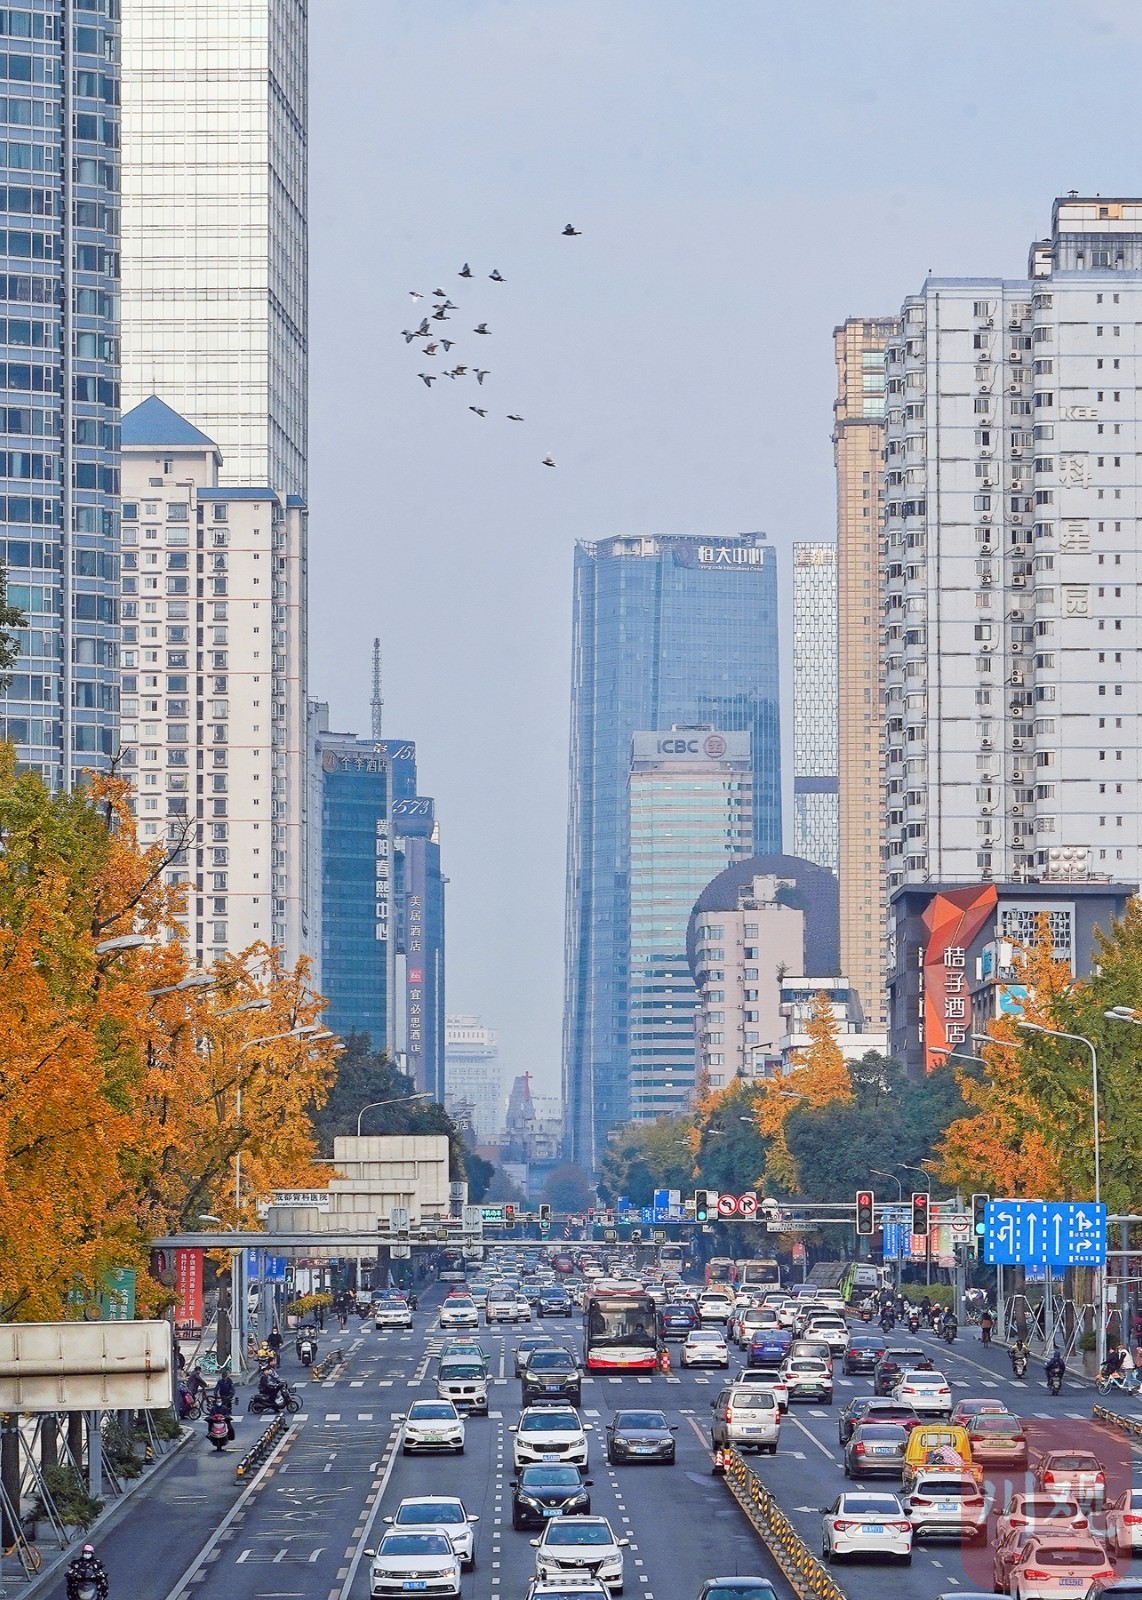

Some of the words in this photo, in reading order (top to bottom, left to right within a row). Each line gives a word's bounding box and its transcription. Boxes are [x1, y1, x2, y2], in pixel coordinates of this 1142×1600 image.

[697, 545, 764, 566] 恒大中心
[656, 738, 699, 754] ICBC
[341, 756, 388, 773] 全季酒店
[391, 799, 430, 815] 1573
[410, 895, 421, 952] 美居酒店
[943, 946, 966, 1044] 桔子酒店
